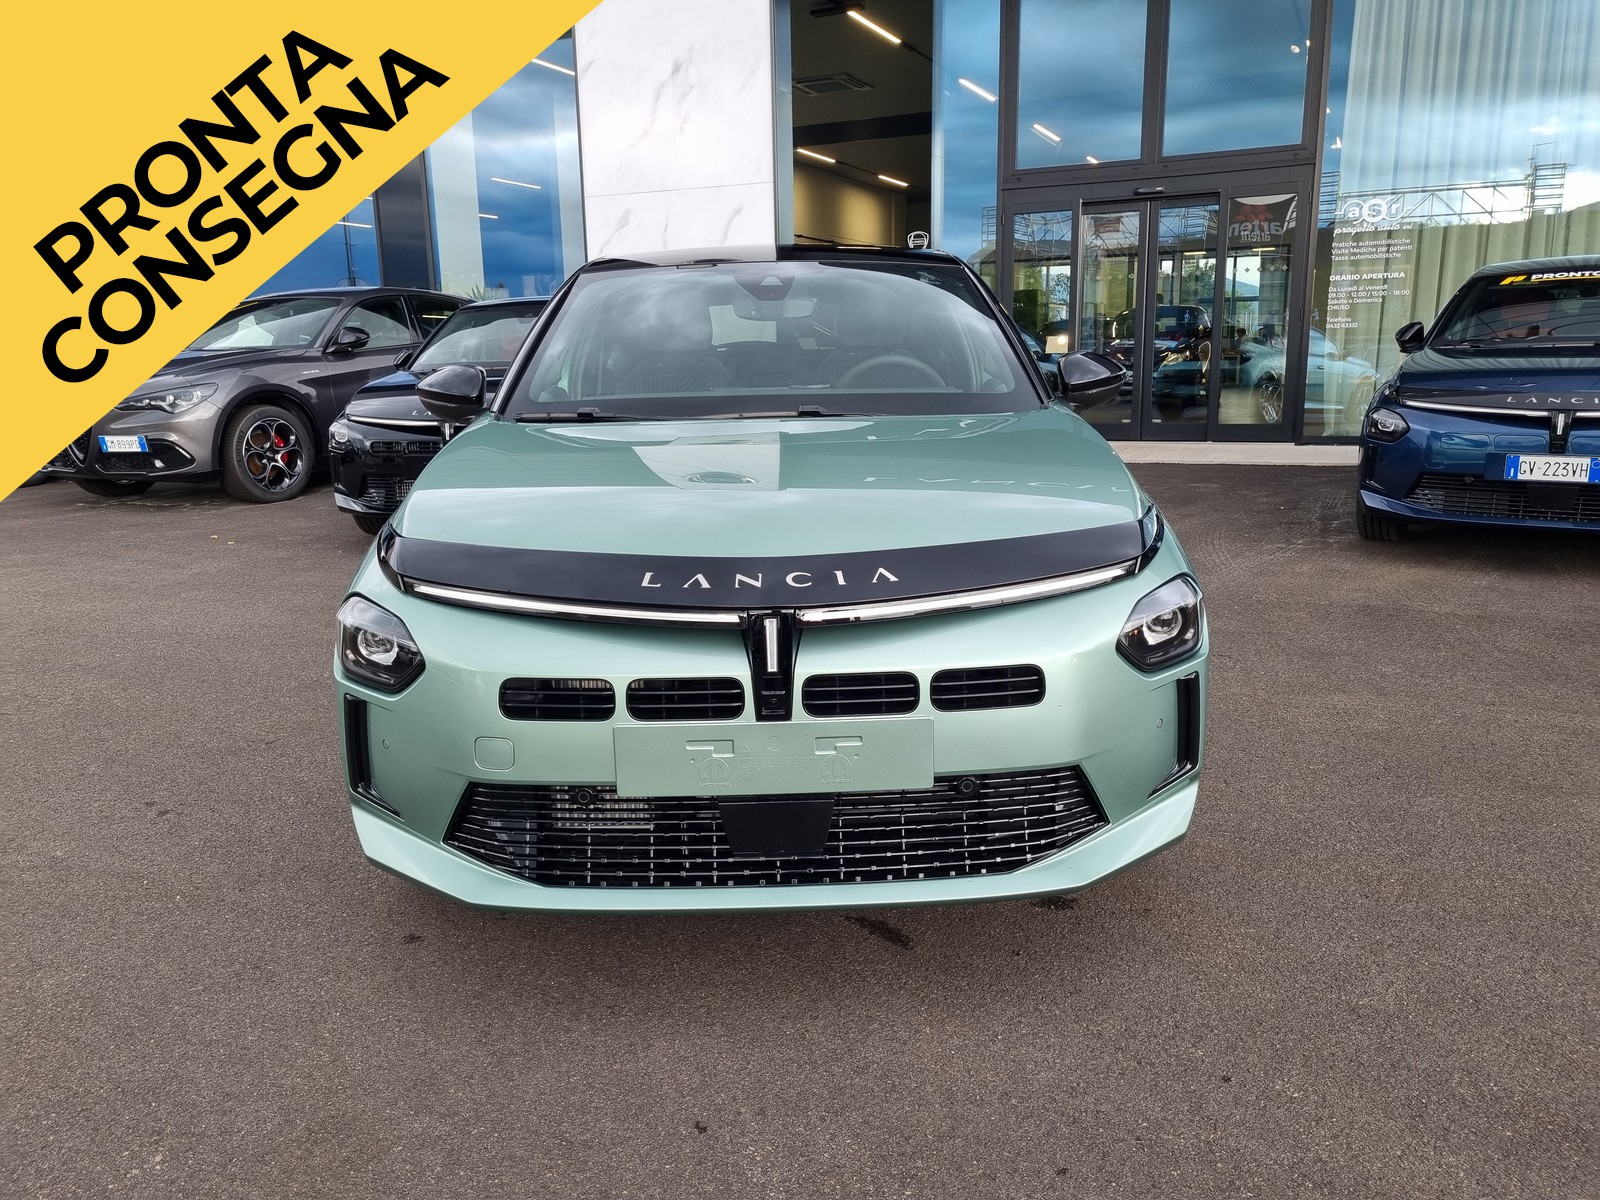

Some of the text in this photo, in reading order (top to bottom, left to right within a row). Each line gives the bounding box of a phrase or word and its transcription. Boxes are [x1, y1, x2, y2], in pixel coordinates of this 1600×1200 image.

[1333, 221, 1375, 237] progetto
[1377, 221, 1401, 231] auto
[1332, 238, 1411, 248] Pratiche automobilistiche
[1350, 246, 1376, 254] Mediche
[1377, 246, 1388, 254] per
[1389, 244, 1413, 253] patenti
[1349, 252, 1402, 260] automobilistiche
[1329, 271, 1406, 281] ORARIO APERTURA
[1519, 460, 1589, 478] GV 223VH
[641, 567, 899, 589] LANCIA
